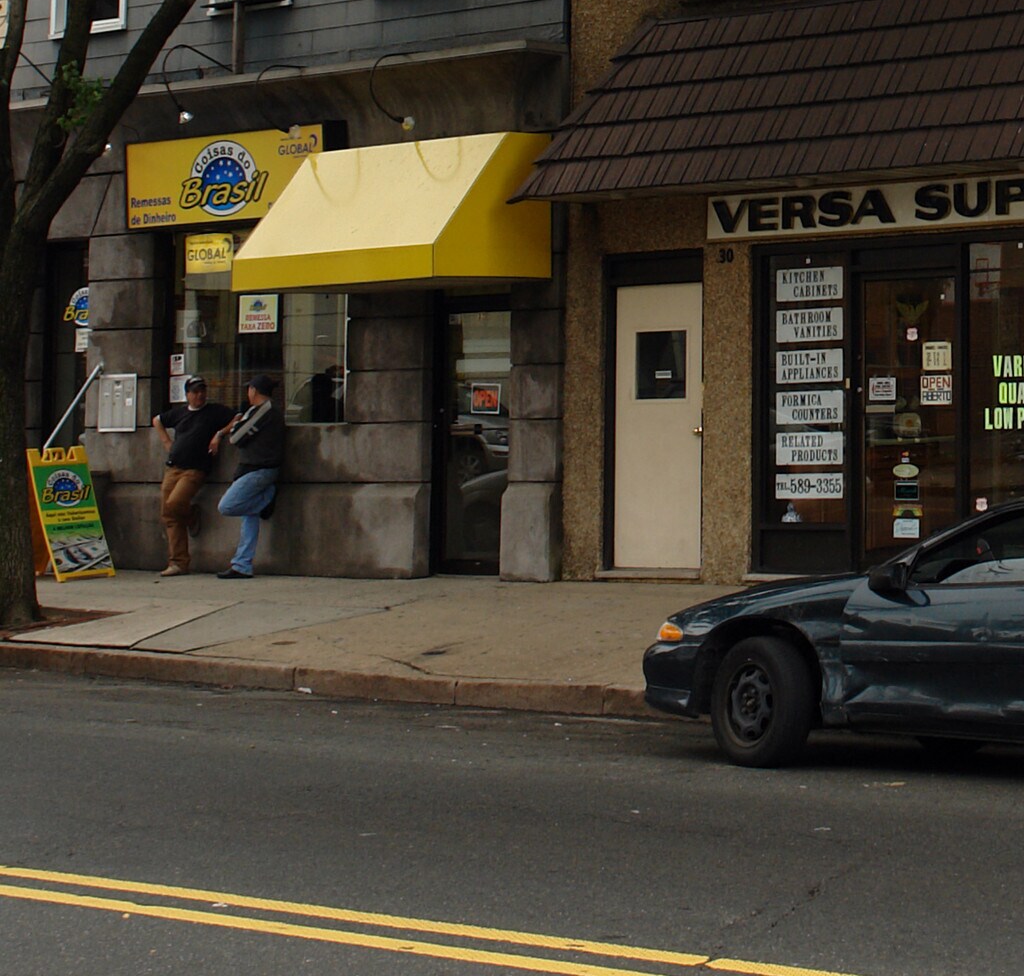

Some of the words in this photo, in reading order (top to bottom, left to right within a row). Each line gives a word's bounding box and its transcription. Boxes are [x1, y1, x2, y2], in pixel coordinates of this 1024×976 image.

[278, 142, 313, 156] GLOBAL
[195, 145, 234, 174] Coisas
[237, 150, 251, 170] do
[179, 170, 269, 210] Brasil
[130, 196, 171, 209] Remessas
[131, 215, 141, 225] de
[143, 211, 177, 225] Dinheiro
[711, 188, 897, 234] VERSA
[187, 247, 227, 261] GLOBAL
[718, 247, 735, 264] 30
[782, 270, 825, 284] KITCHEN
[793, 284, 839, 298] CABINETS
[782, 311, 832, 325] BATHROOM
[794, 325, 838, 339] VANITIES
[781, 352, 826, 366] BUILT-IN
[782, 366, 839, 380] APPLIANCES
[921, 376, 951, 389] OPEN
[473, 389, 499, 409] OPEN
[781, 393, 822, 407] FORMICA
[922, 390, 952, 402] ABERTO
[792, 407, 838, 421] COUNTERS
[984, 407, 1014, 431] LOW
[781, 435, 824, 449] RELATED
[791, 448, 838, 462] PRODUCTS
[790, 478, 842, 494] 589-3355
[41, 485, 92, 504] Brasil
